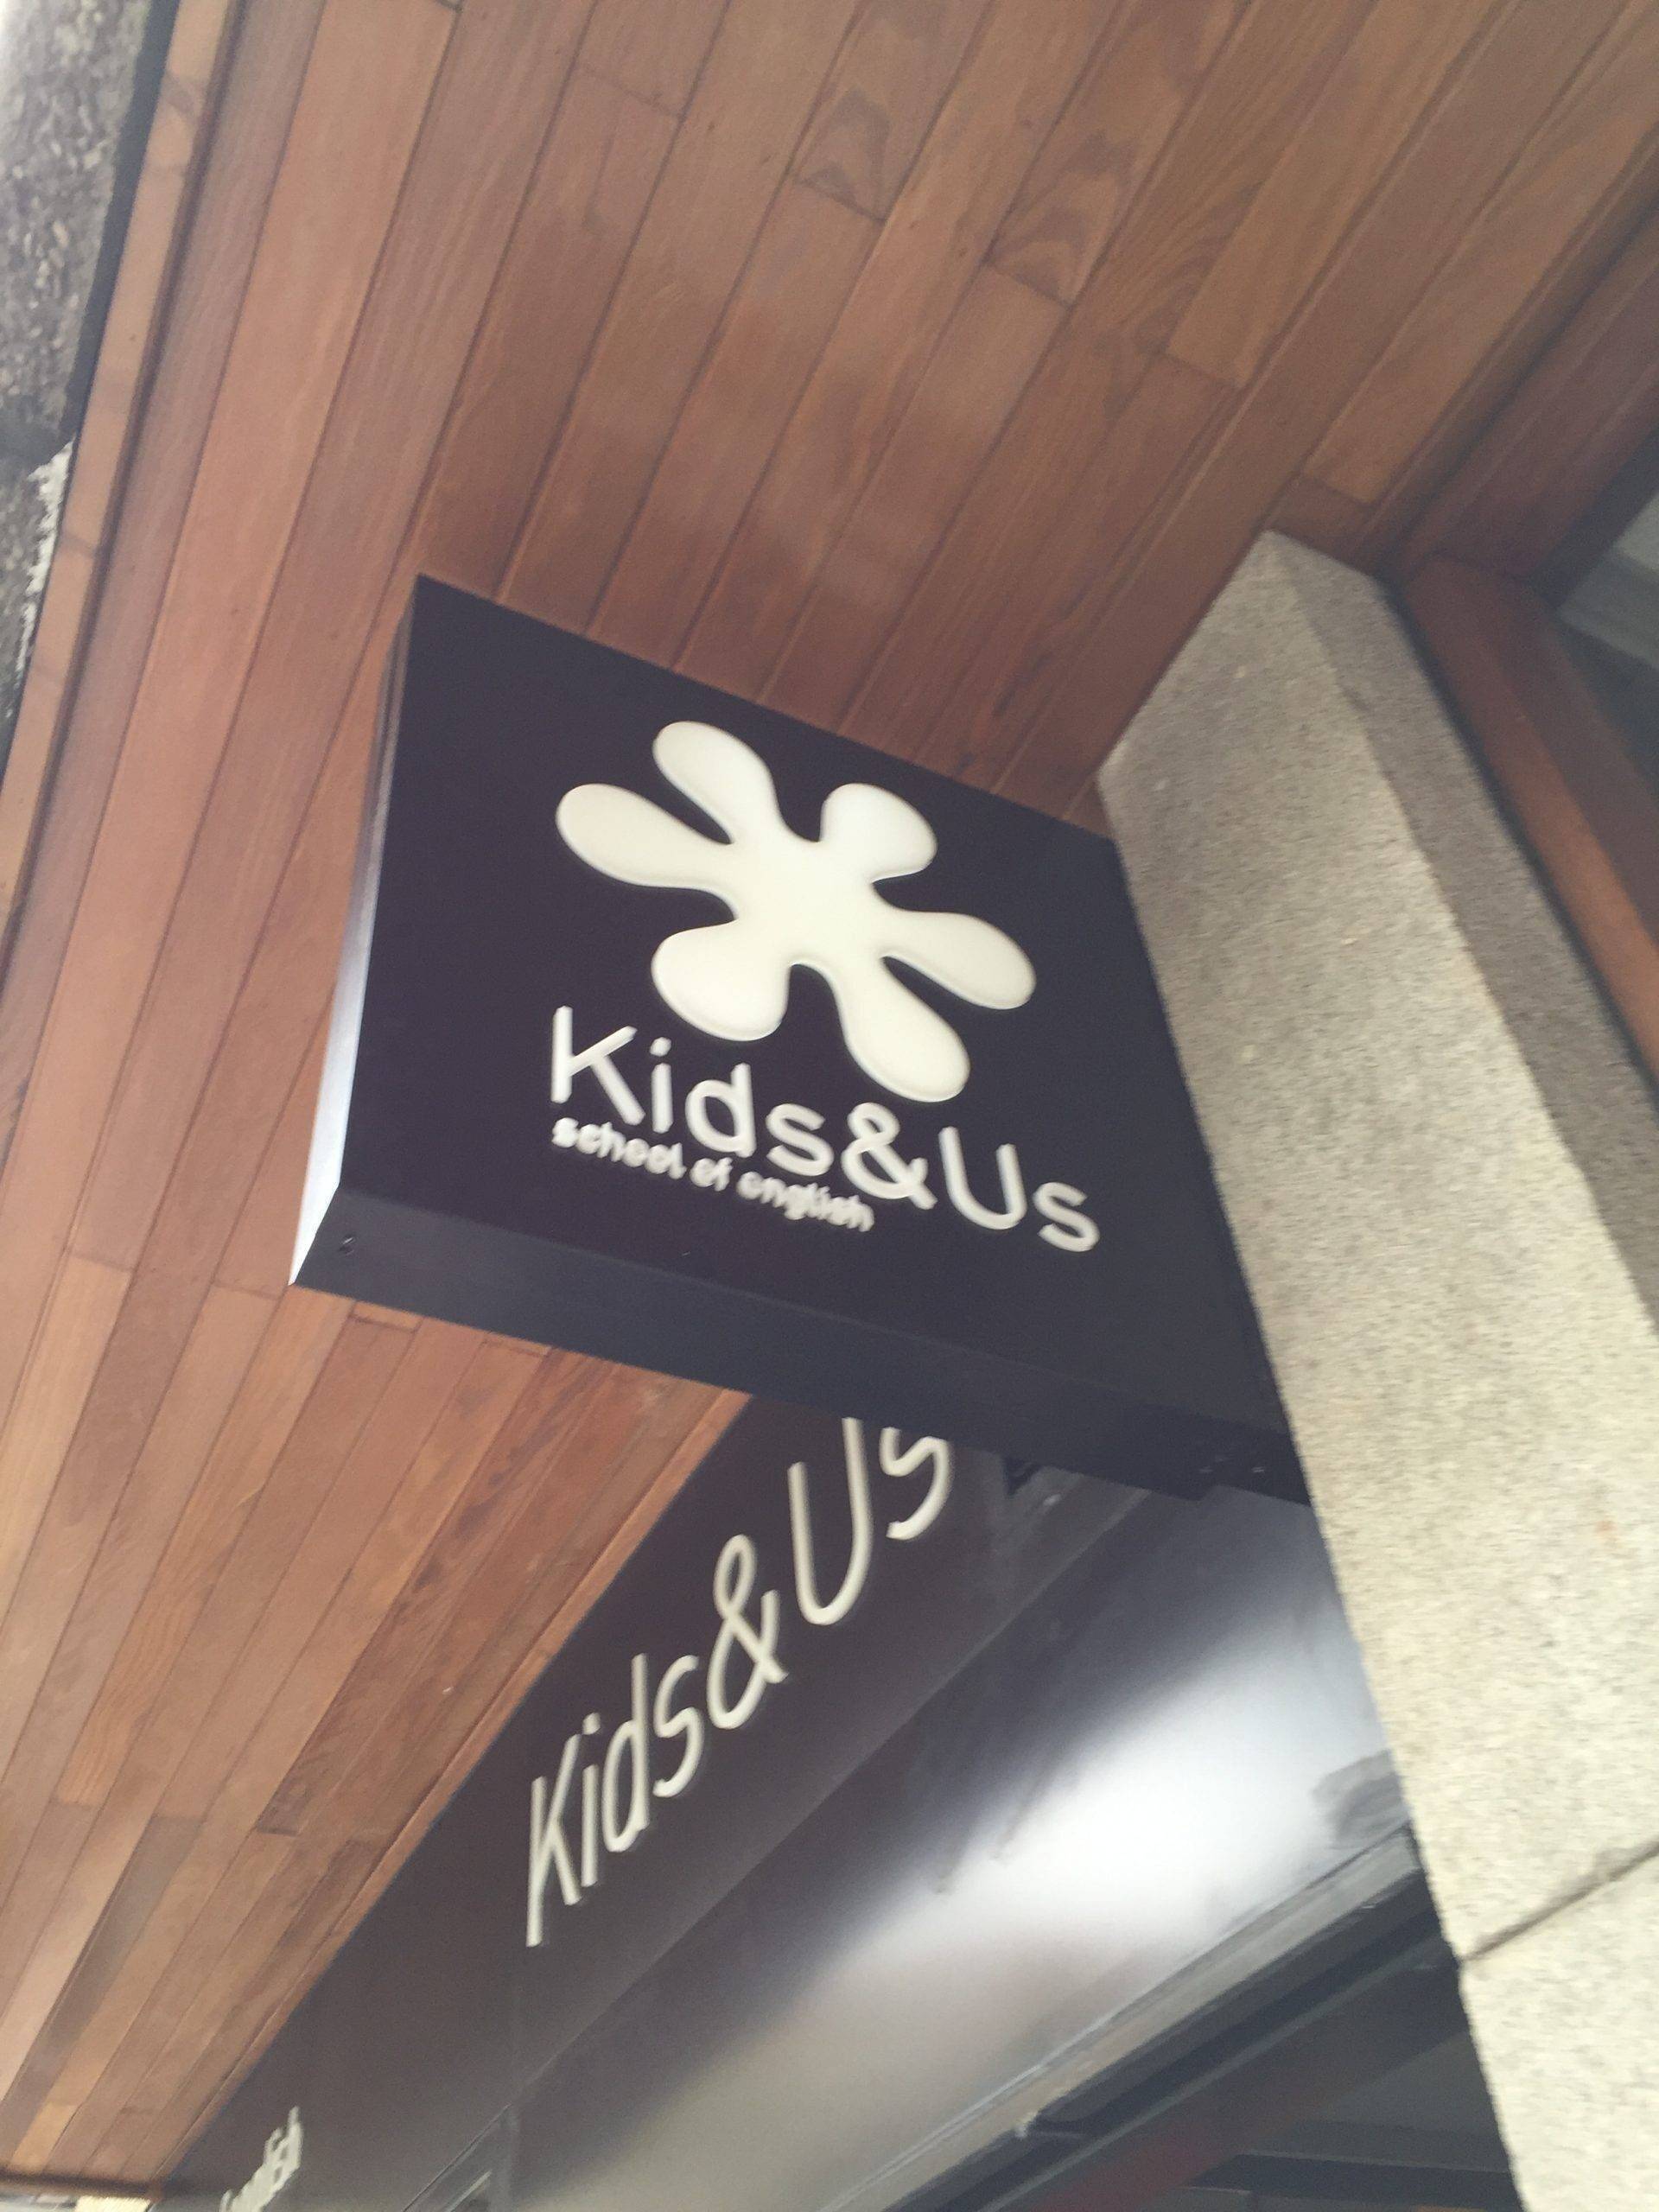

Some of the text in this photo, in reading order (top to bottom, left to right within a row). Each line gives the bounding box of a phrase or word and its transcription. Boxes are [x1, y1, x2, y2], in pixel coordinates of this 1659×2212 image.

[550, 1005, 1101, 1253] Kids&Us
[551, 1116, 875, 1233] school of english
[525, 1417, 950, 1948] Kids&Us
